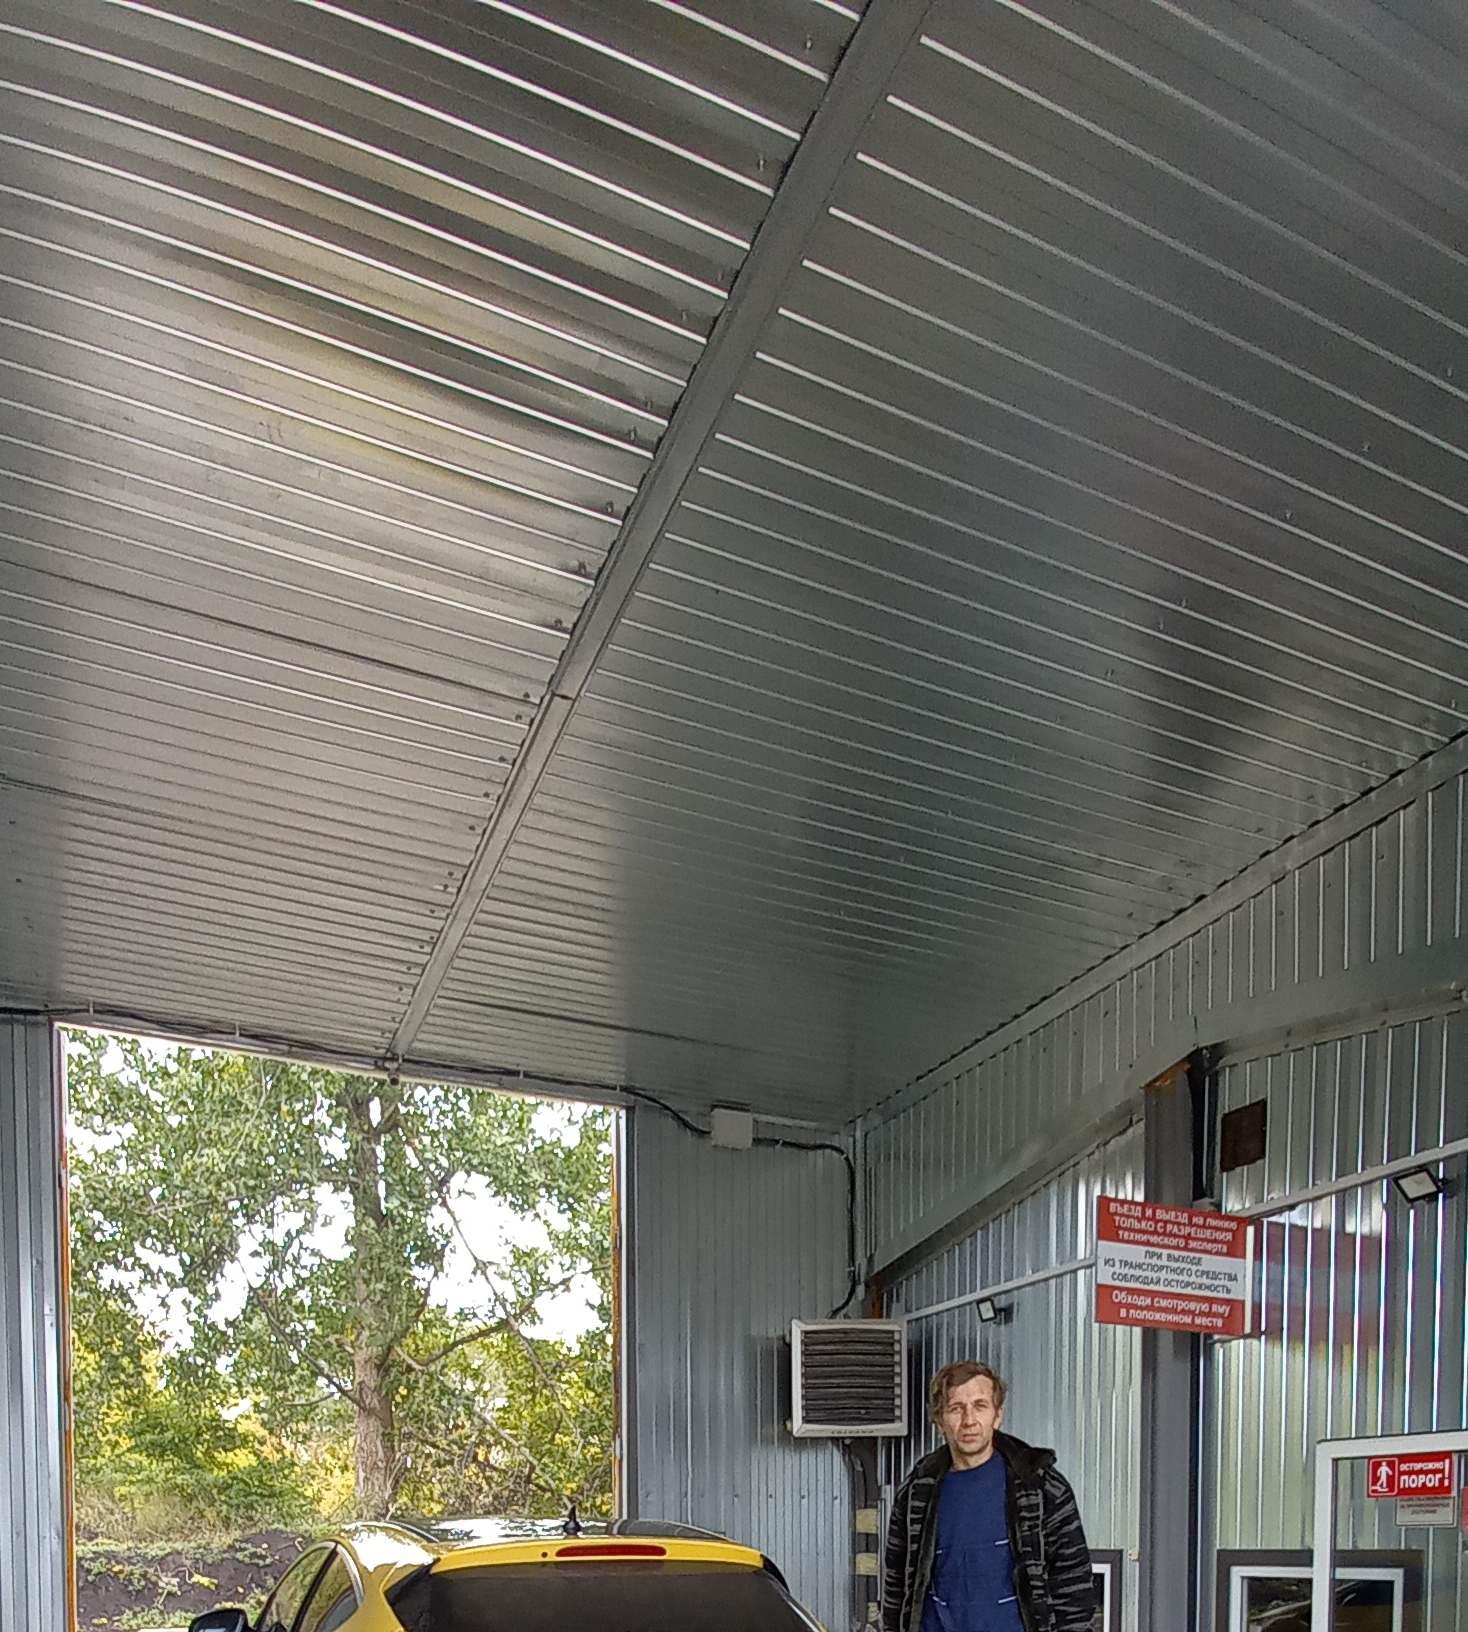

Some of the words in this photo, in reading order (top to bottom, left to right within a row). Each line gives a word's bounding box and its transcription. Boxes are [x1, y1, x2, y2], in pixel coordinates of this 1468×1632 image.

[1109, 1202, 1142, 1217] ВЪЕЗД
[1145, 1207, 1153, 1218] И
[1155, 1209, 1189, 1225] ВЫЕЗД
[1205, 1217, 1238, 1230] линию
[1113, 1216, 1155, 1231] ТОЛЬКО
[1157, 1221, 1165, 1232] С
[1166, 1224, 1233, 1242] РАЗРЕШЕНИЯ
[1118, 1230, 1185, 1247] технического
[1187, 1241, 1228, 1254] эксперта
[1104, 1256, 1116, 1268] ИЗ
[1118, 1259, 1193, 1277] ТРАНСПОРТНОГО
[1194, 1270, 1238, 1283] СРЕДСТВА
[1144, 1250, 1163, 1260] ПРИ
[1166, 1253, 1203, 1266] ВЫХОДЕ
[1111, 1271, 1162, 1286] СОБЛЮДАЙ
[1162, 1278, 1232, 1295] ОСТОРОЖНОСТЬ
[1112, 1290, 1152, 1306] Обходи
[1153, 1298, 1210, 1315] смотровую
[1211, 1305, 1231, 1317] яму
[1129, 1309, 1192, 1324] положенном
[1194, 1316, 1223, 1328] месте
[1399, 1461, 1444, 1471] ОСТОРОЖНО
